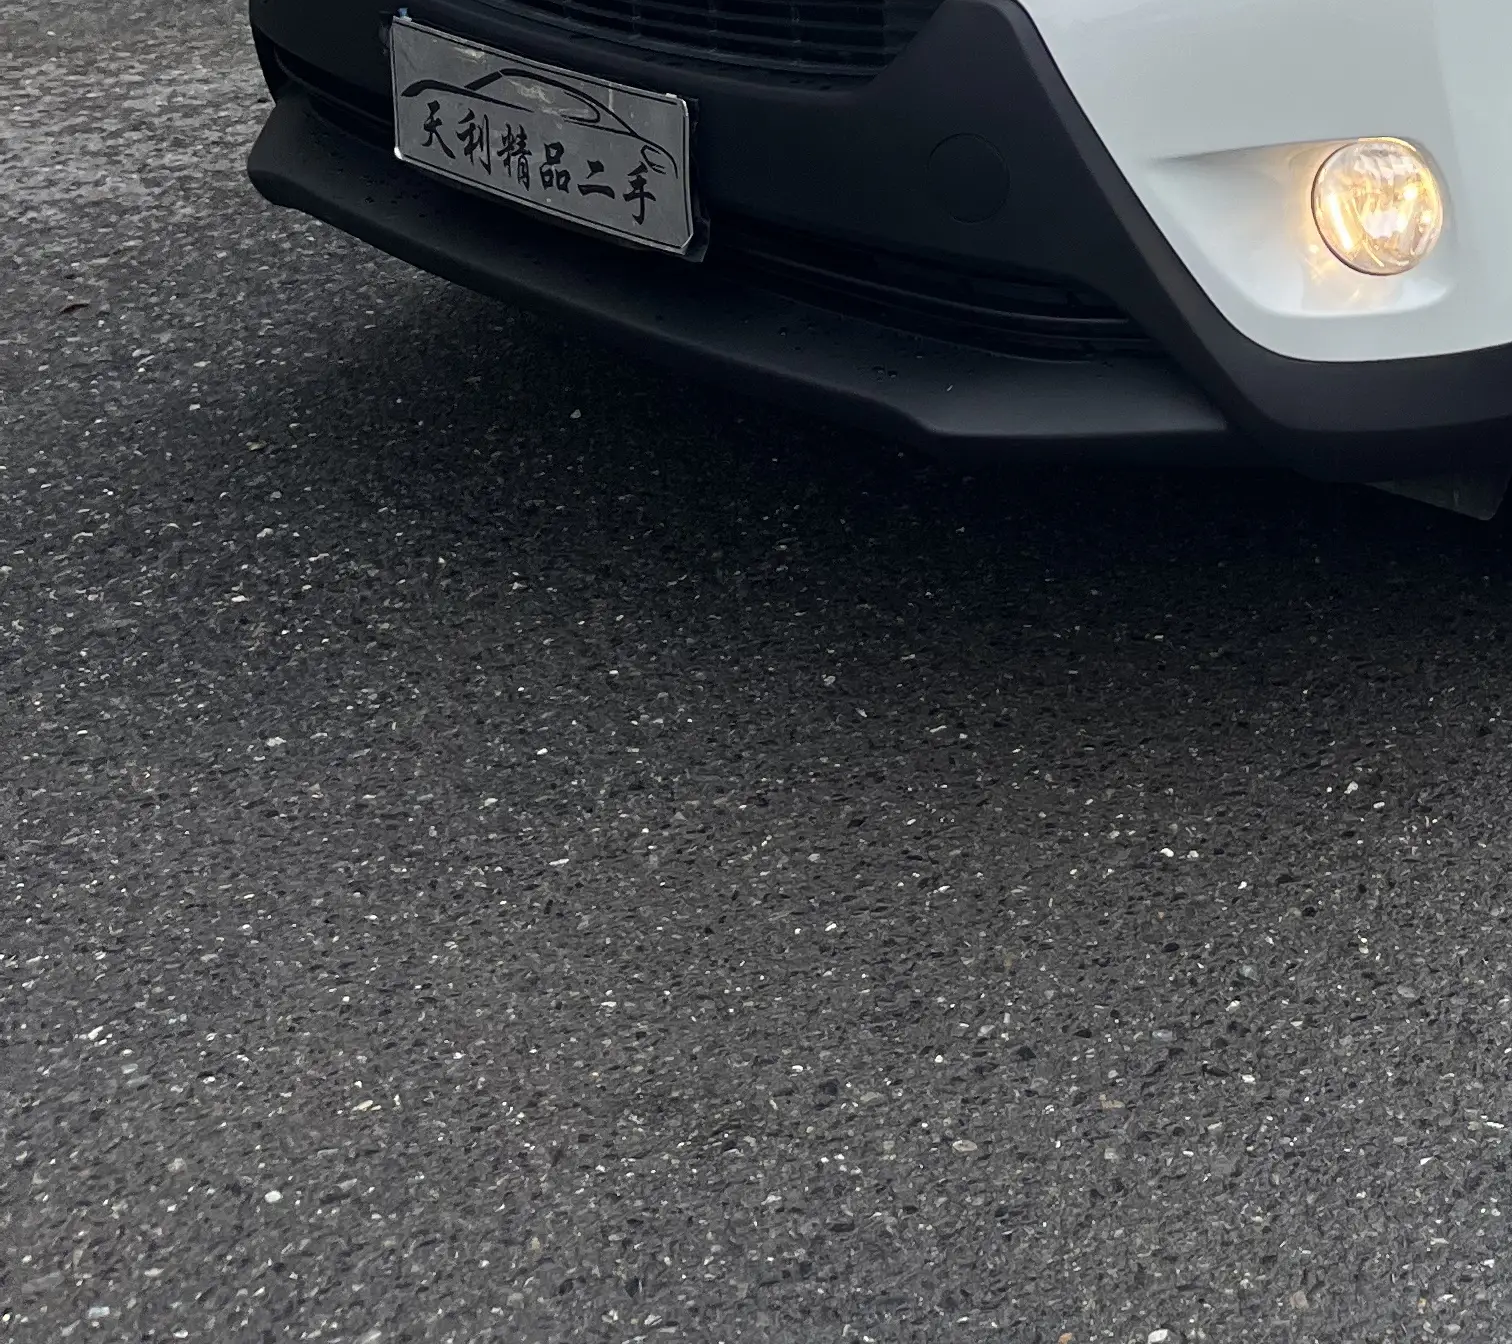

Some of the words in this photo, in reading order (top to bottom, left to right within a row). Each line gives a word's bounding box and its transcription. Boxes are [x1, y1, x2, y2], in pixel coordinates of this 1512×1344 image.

[421, 100, 657, 226] 天利精品二手
